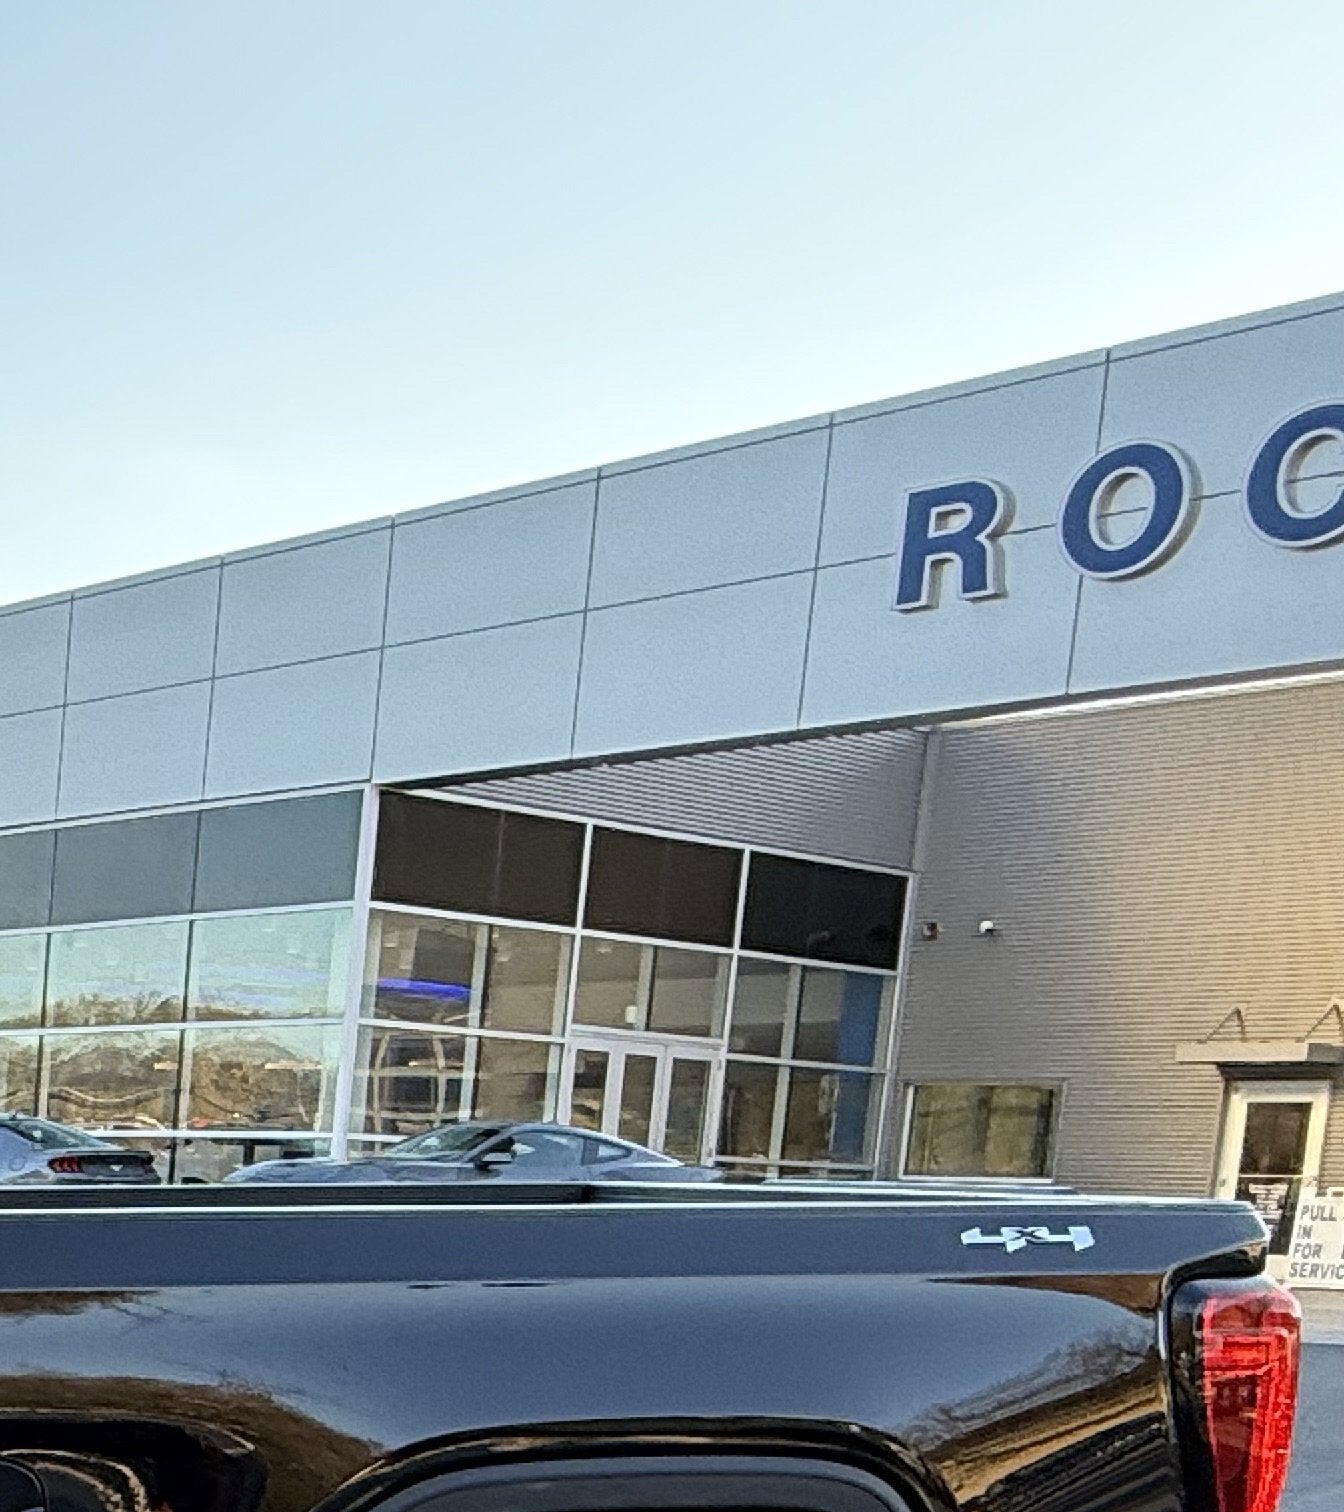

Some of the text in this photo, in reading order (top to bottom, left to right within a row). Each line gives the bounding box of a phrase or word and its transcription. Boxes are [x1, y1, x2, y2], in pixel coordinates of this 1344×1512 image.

[1301, 1204, 1337, 1222] PULL
[1296, 1224, 1313, 1240] IN
[1293, 1242, 1323, 1260] FOR
